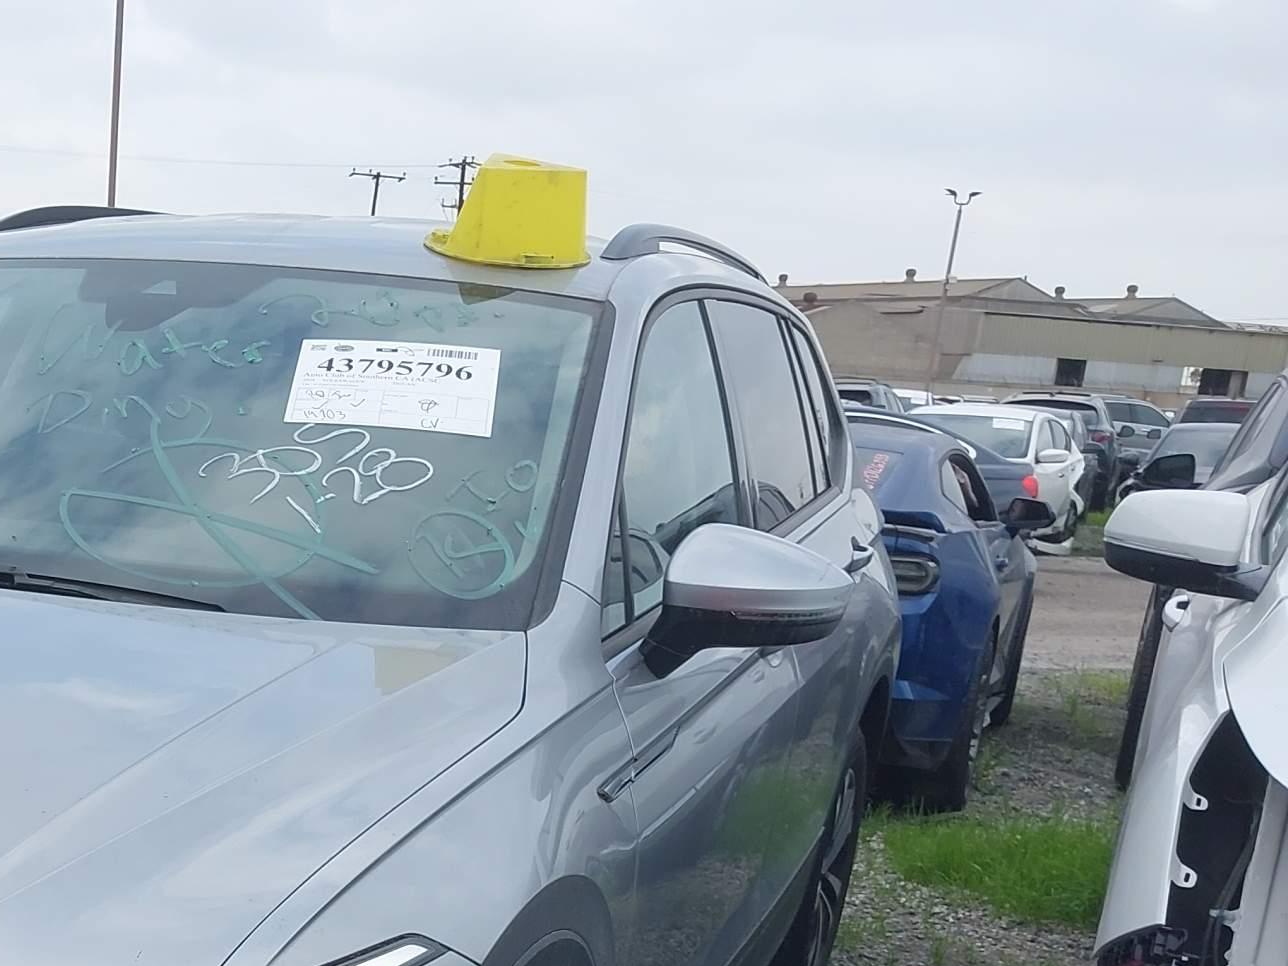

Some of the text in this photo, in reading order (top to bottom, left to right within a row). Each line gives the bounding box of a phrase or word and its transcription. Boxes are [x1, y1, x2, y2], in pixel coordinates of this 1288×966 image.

[316, 357, 474, 381] 43795796
[325, 371, 345, 379] Club
[358, 373, 394, 381] Southern
